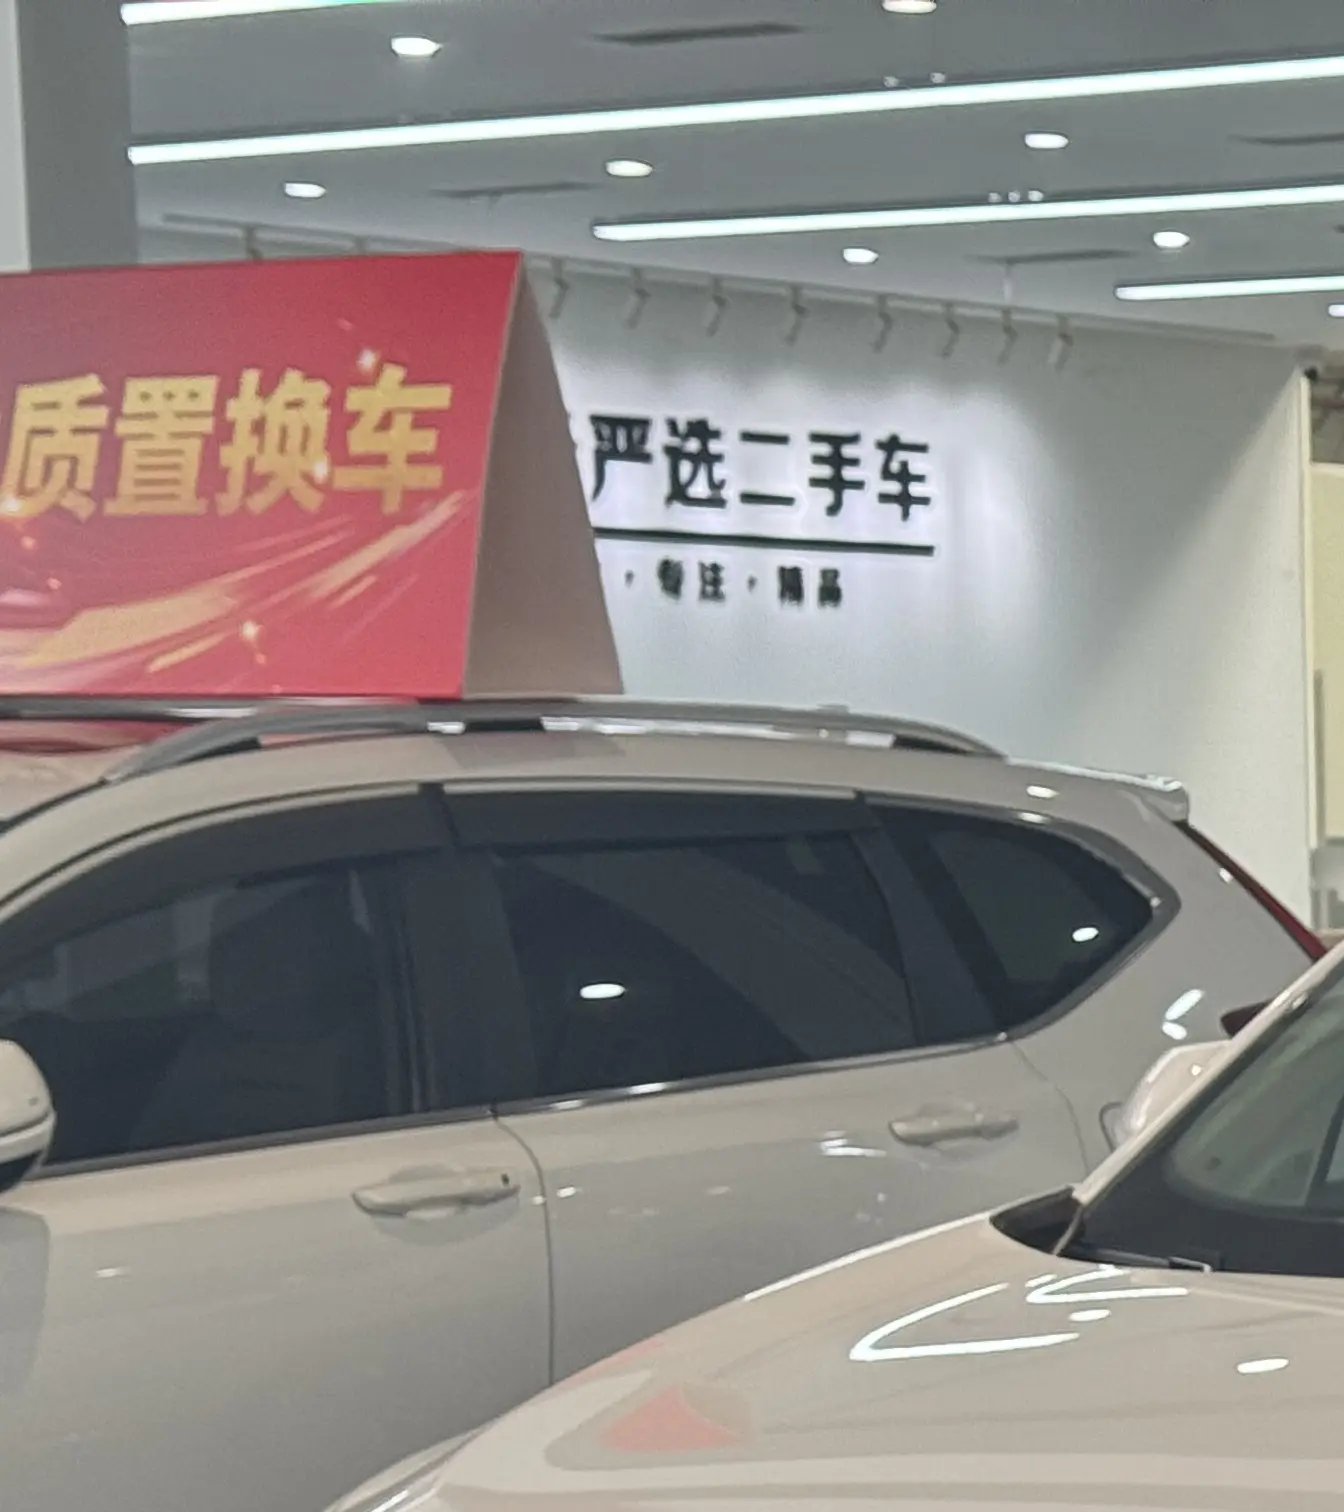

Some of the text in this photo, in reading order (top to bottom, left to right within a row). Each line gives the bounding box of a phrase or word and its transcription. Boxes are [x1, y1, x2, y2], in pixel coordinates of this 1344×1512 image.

[1, 362, 454, 522] 质置换车
[589, 414, 932, 521] 严选二手车
